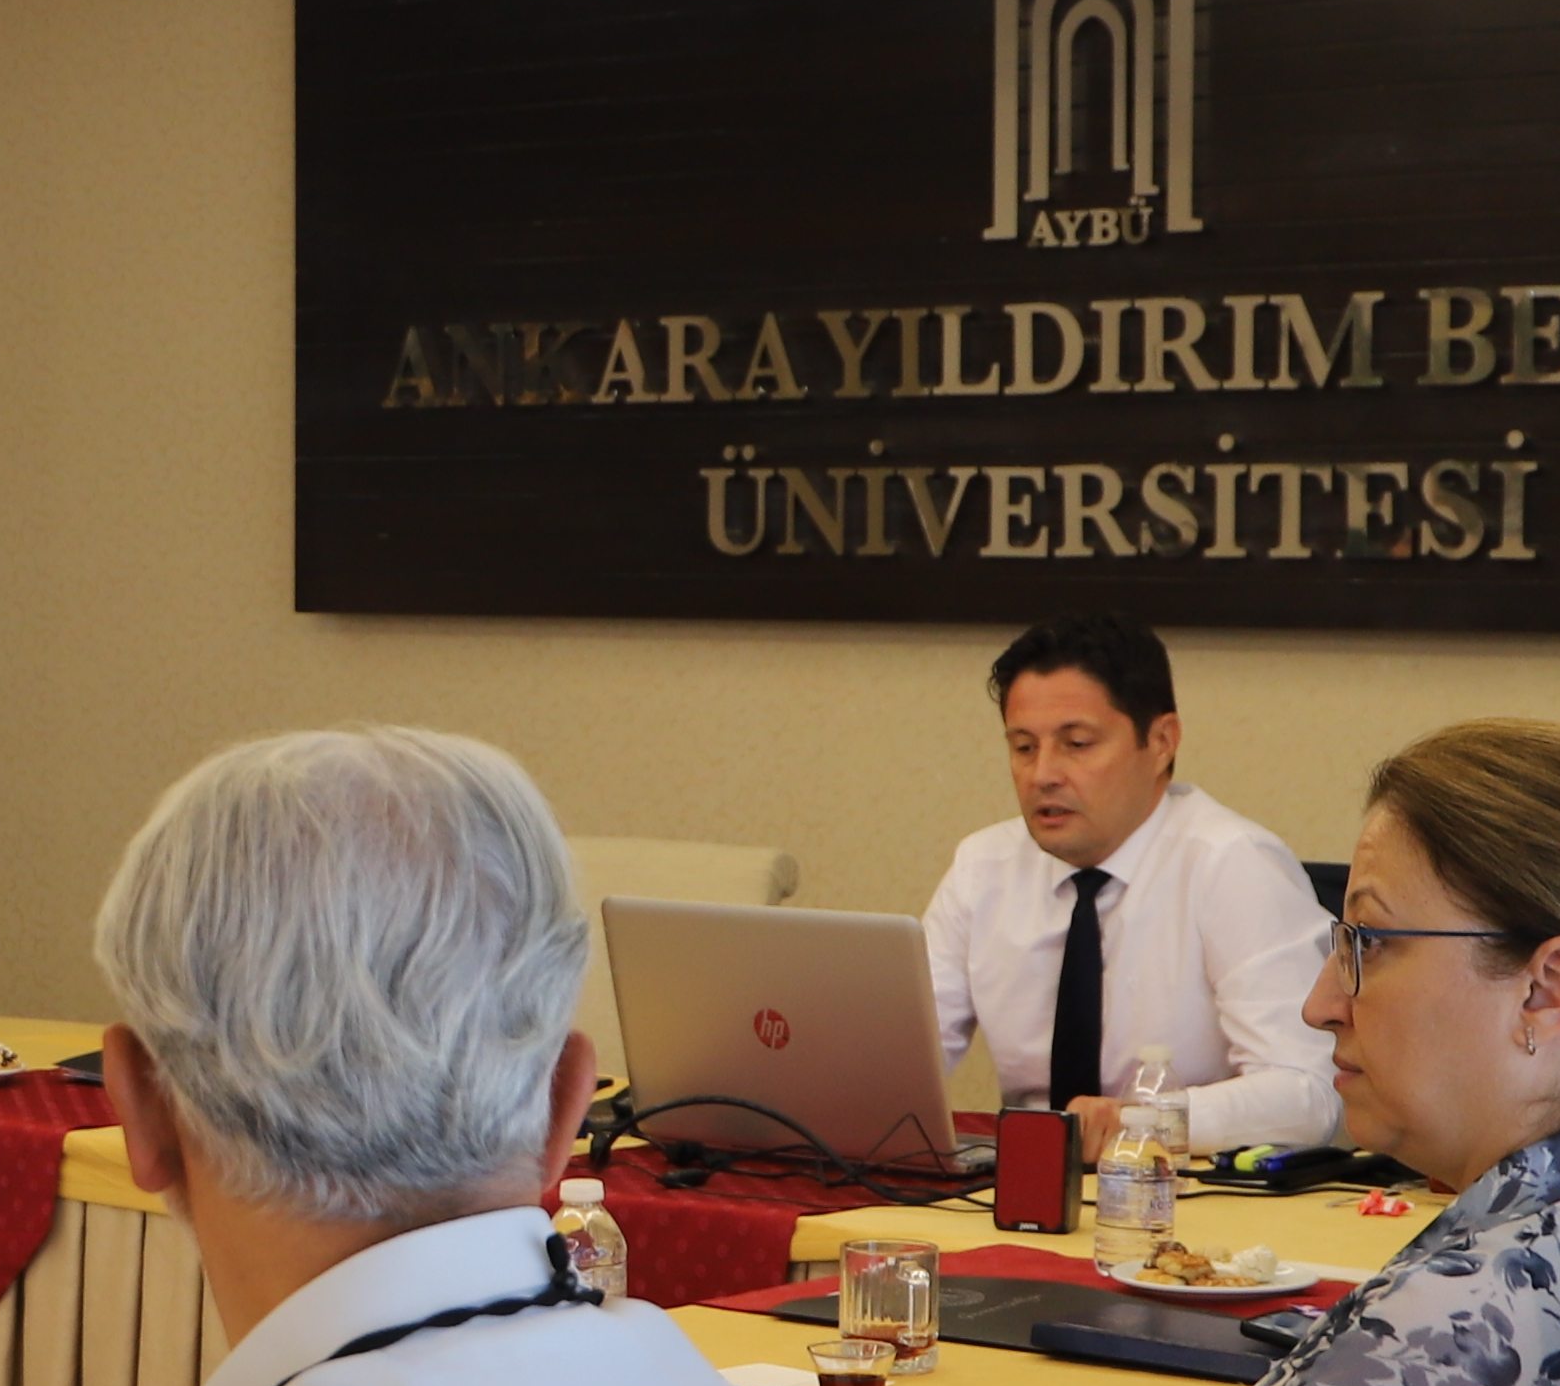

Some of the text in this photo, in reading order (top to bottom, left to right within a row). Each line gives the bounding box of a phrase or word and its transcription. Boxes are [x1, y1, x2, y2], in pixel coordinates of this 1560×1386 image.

[1027, 196, 1154, 248] AYBÜ
[381, 310, 809, 408] ANKARA
[817, 290, 1386, 399] YILDIRIM
[699, 428, 1539, 560] ÜNİVERSİTESİ
[760, 1008, 786, 1049] hp
